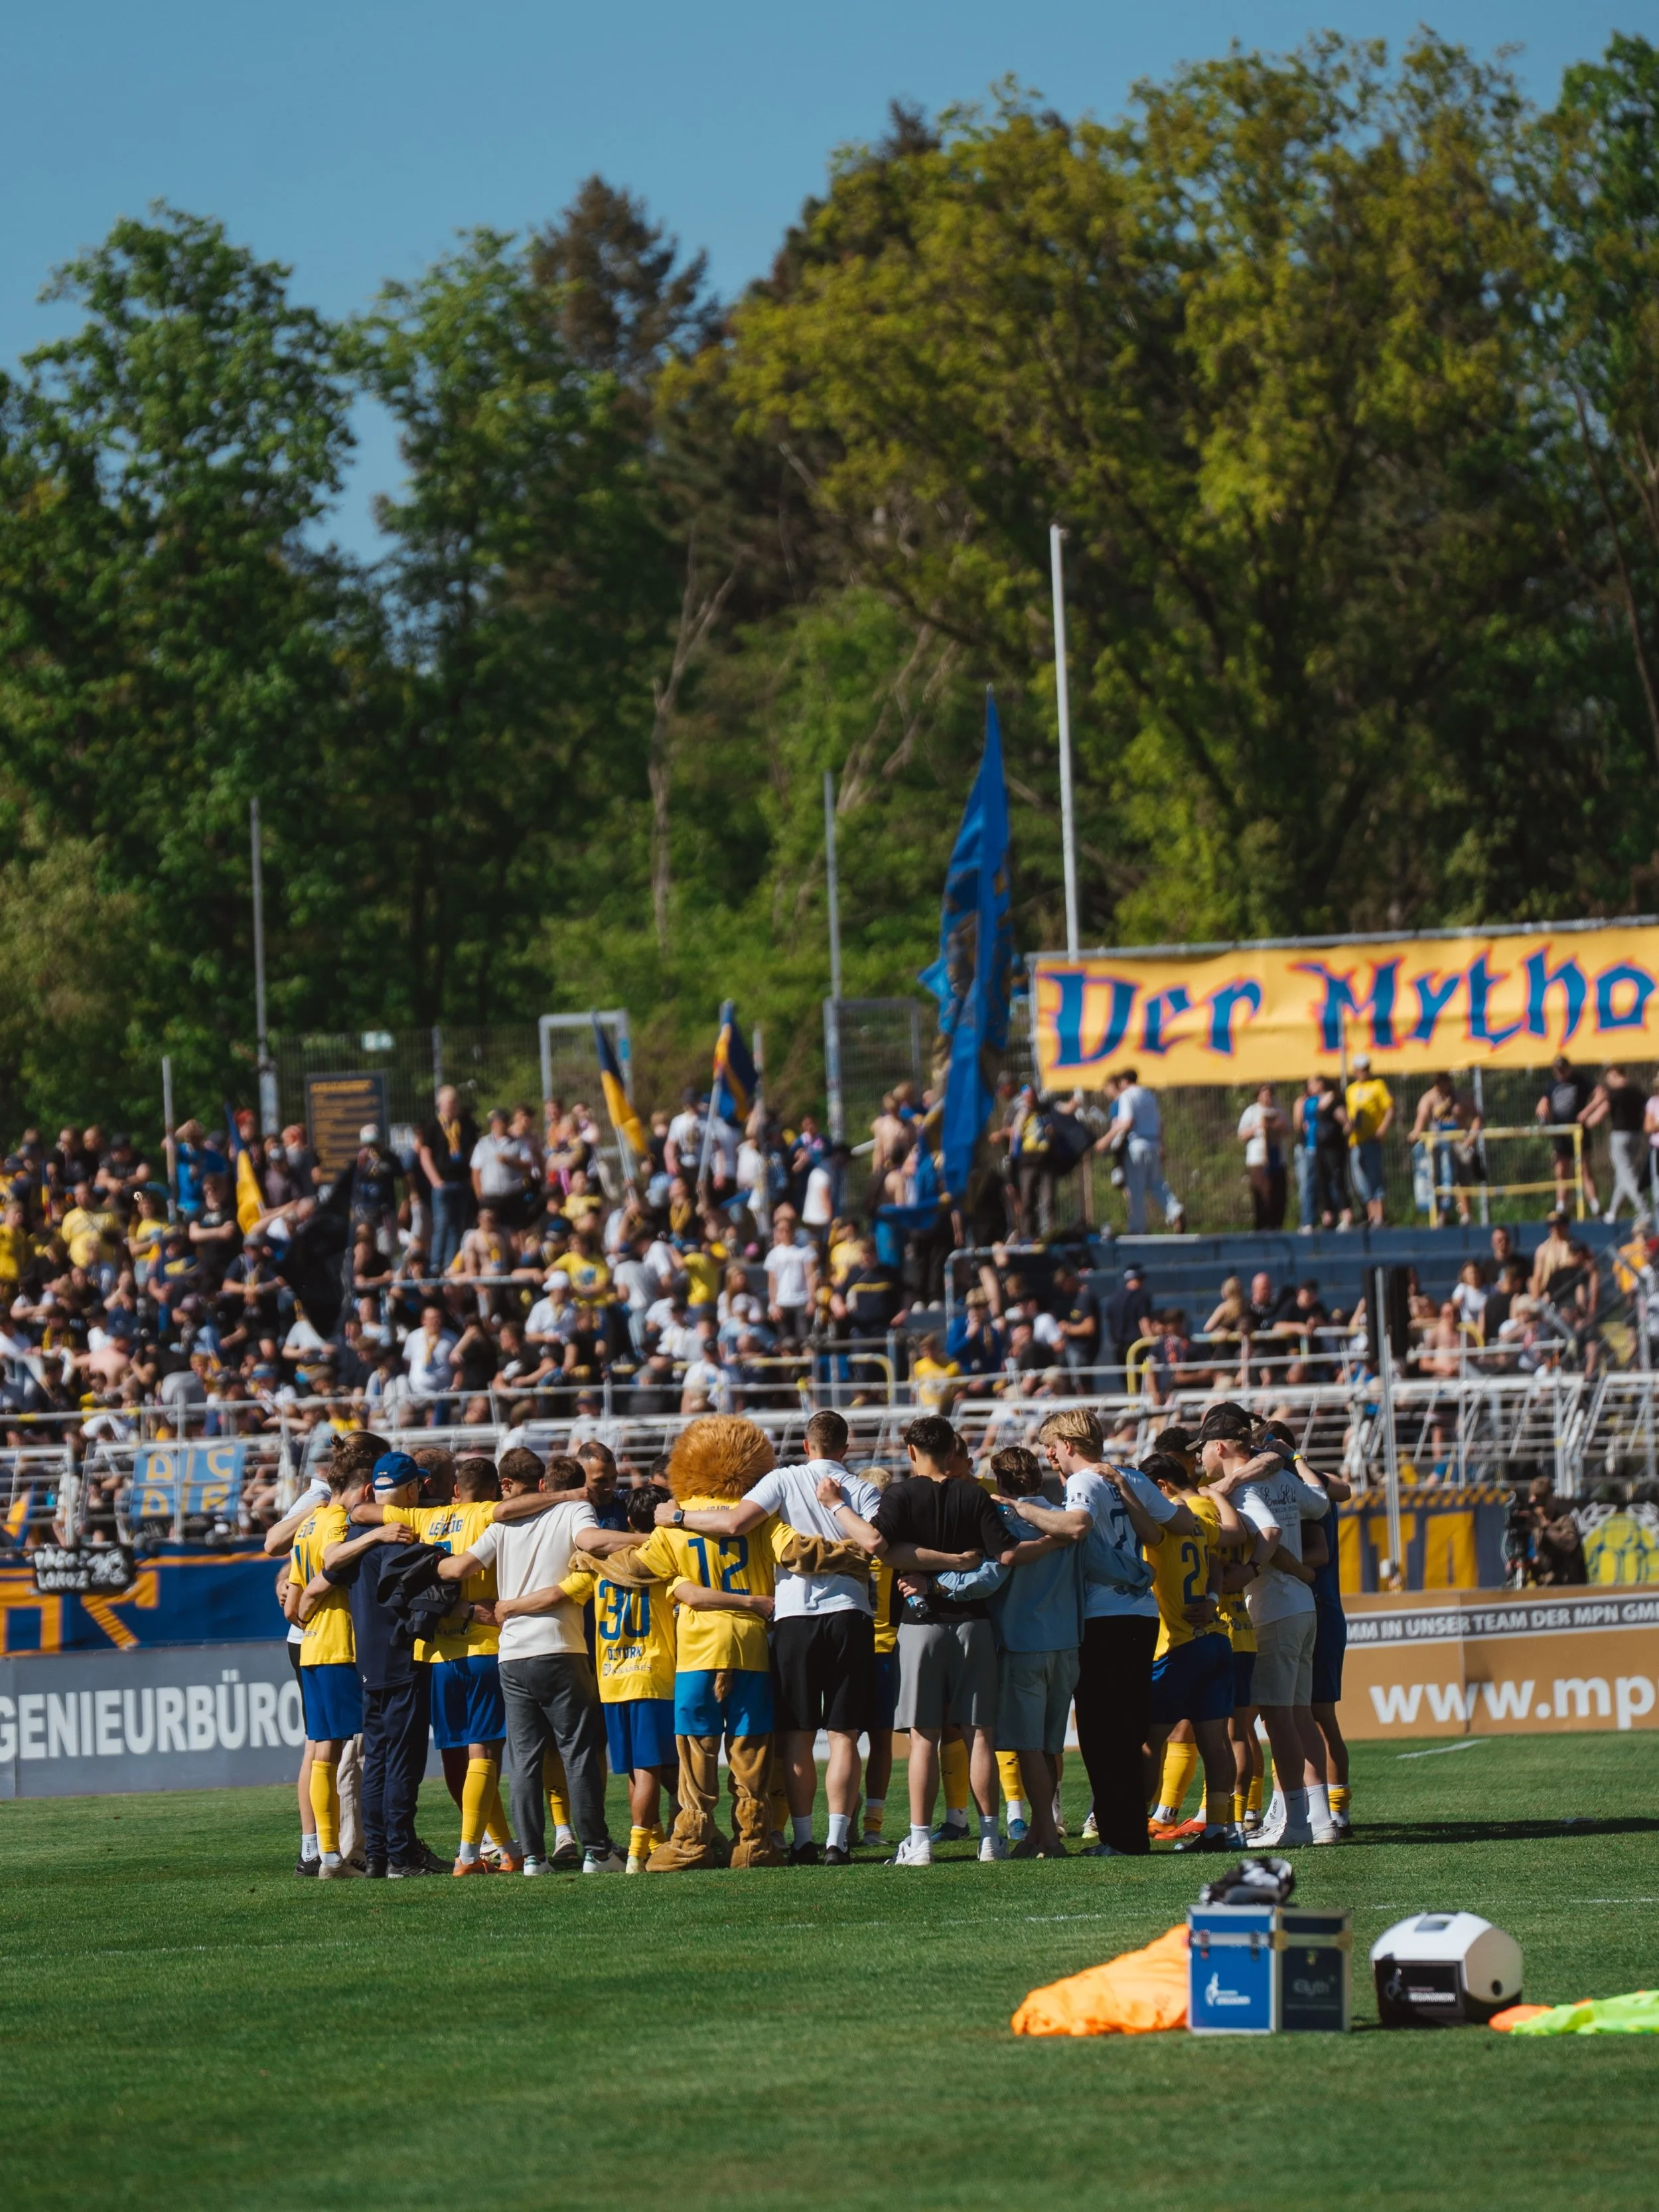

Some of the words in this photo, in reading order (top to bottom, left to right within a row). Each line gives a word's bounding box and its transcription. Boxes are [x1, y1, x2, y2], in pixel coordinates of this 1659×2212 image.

[1038, 966, 1263, 1069] Der
[1287, 942, 1658, 1055] Mytho
[428, 1518, 463, 1536] LEIG
[688, 1535, 750, 1595] 12
[1181, 1542, 1210, 1604] 2
[598, 1580, 651, 1641] 30
[1380, 1619, 1403, 1639] IN
[1405, 1615, 1471, 1637] UNSER
[1473, 1611, 1528, 1632] TEAM
[1530, 1607, 1571, 1628] DER
[1573, 1604, 1619, 1625] MPN
[1622, 1601, 1659, 1622] GM
[0, 1668, 305, 1762] GENIEURBÜRO
[1368, 1675, 1659, 1731] www.mp
